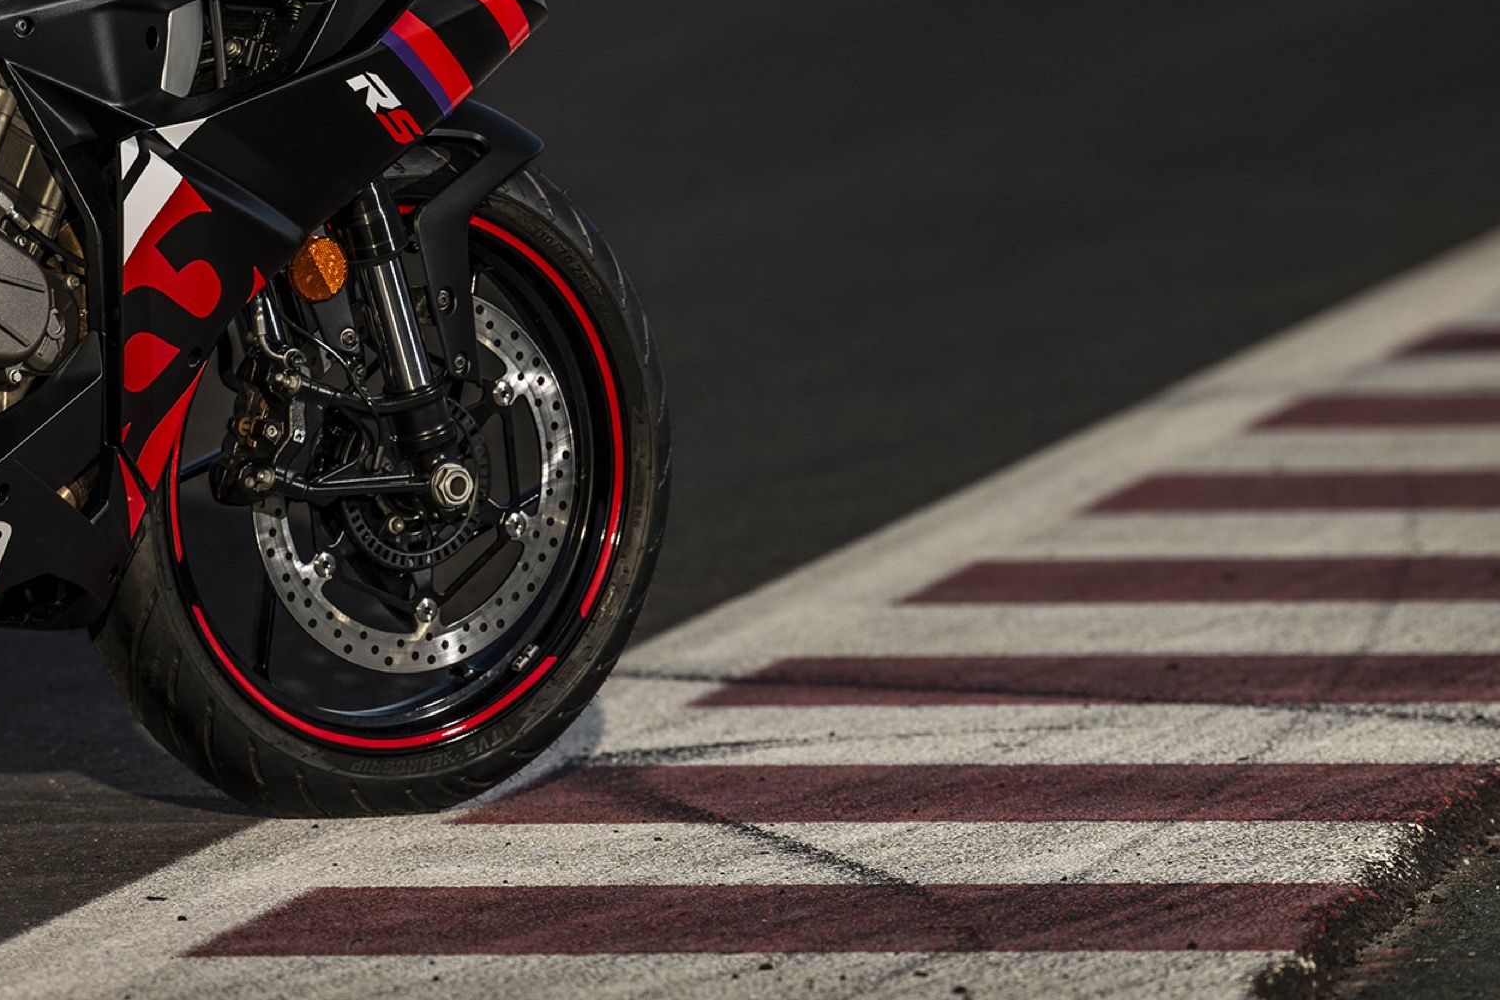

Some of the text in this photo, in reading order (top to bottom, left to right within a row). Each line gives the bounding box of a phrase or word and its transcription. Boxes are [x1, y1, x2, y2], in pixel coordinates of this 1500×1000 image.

[346, 71, 424, 145] RS
[349, 729, 504, 776] TVS EUROGRIP
